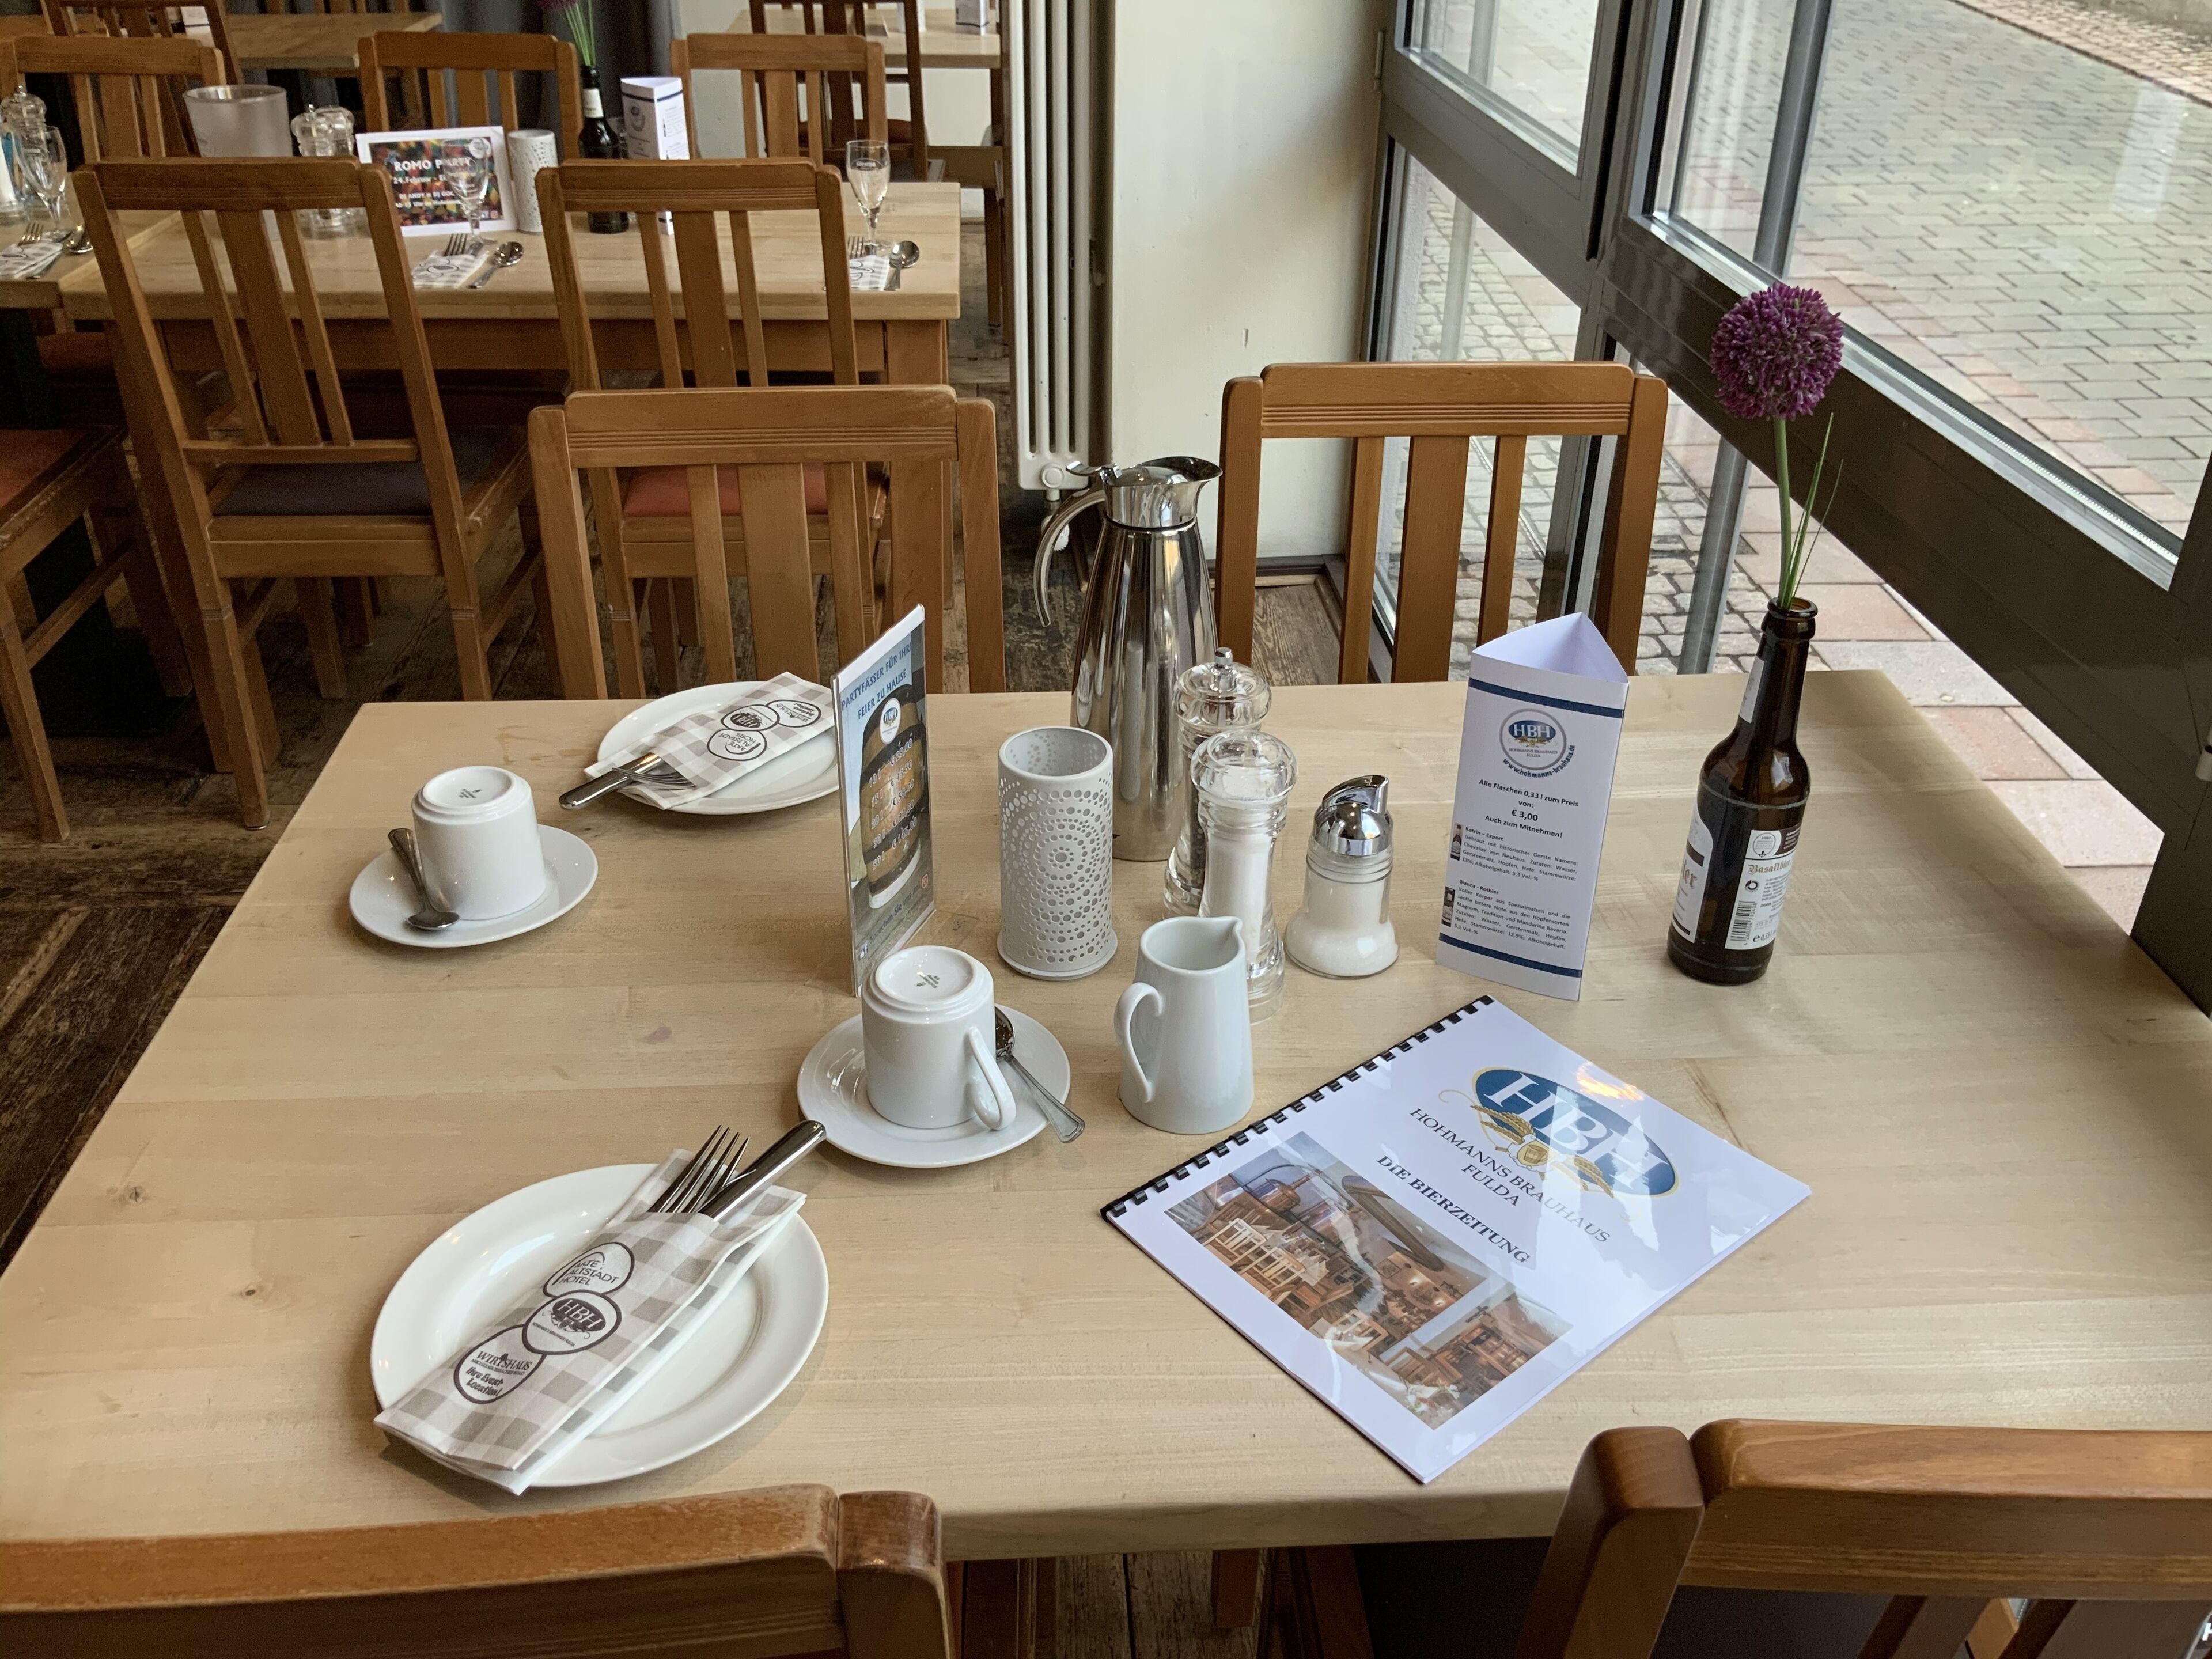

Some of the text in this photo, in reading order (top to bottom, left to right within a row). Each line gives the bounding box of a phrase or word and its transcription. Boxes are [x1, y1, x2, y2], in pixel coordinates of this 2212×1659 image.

[393, 157, 471, 171] ROMO PARTY
[841, 666, 884, 711] PARTYFÄSSER
[885, 655, 897, 672] FÜR
[858, 669, 907, 720] FEIER ZU HAUSE
[732, 714, 758, 727] HBH
[718, 733, 752, 747] ALTSTADT
[736, 733, 756, 744] HOTEL
[1513, 724, 1551, 738] HBH
[728, 741, 746, 751] ARTE
[1503, 745, 1575, 778] www.hohmanns-brauhaus.de
[869, 772, 877, 788] 10
[1479, 779, 1492, 787] Alle
[1493, 783, 1522, 795] Flaschen
[1524, 790, 1539, 799] 0,33
[1561, 798, 1579, 807] Preis
[1518, 800, 1534, 808] von:
[1519, 810, 1539, 821] 3,00
[1465, 827, 1480, 835] Katrin
[1486, 833, 1503, 841] Export
[1484, 815, 1502, 824] Auch
[1519, 824, 1563, 838] Mitnehmen!
[1464, 834, 1485, 844] Gebraut
[1499, 844, 1530, 855] historischer
[1463, 850, 1495, 863] Gerstenmalz,
[1498, 859, 1518, 869] Hopfen,
[1539, 869, 1577, 881] Stammwürze:
[1464, 842, 1487, 853] Chevalier
[1530, 859, 1552, 868] Zutaten:
[1555, 865, 1577, 874] Wasser,
[1475, 861, 1511, 874] Alkoholgehalt:
[1459, 879, 1476, 888] Bianca
[1480, 885, 1499, 895] Rotbier
[893, 904, 902, 916] Sie
[1459, 887, 1473, 895] Voller
[1476, 892, 1493, 901] Körper
[1508, 901, 1544, 914] Spezialmalzen
[1456, 902, 1480, 913] Magnum,
[1482, 910, 1504, 919] Tradition
[1517, 919, 1545, 930] Mandarina
[1475, 900, 1492, 908] bittere
[1532, 915, 1569, 927] Hopfensorten
[1456, 909, 1566, 942] Zutaten: Wasser, Gerstenmalz, Hopfen,
[1471, 921, 1505, 934] Stammwürze:
[1528, 937, 1566, 949] Alkoholgehalt:
[1483, 1073, 1670, 1190] HBH
[1410, 1108, 1611, 1243] HOHMANNS BRAUHAUS
[1461, 1164, 1520, 1207] FULDA
[1376, 1154, 1531, 1263] DIE BIERZEITUNG
[559, 1275, 592, 1285] HOTEL
[566, 1267, 620, 1283] ALTSTADT
[557, 1299, 604, 1329] HBH
[476, 1351, 533, 1370] WIRTSHAUS
[465, 1366, 483, 1378] Ihre
[466, 1377, 503, 1396] Location!
